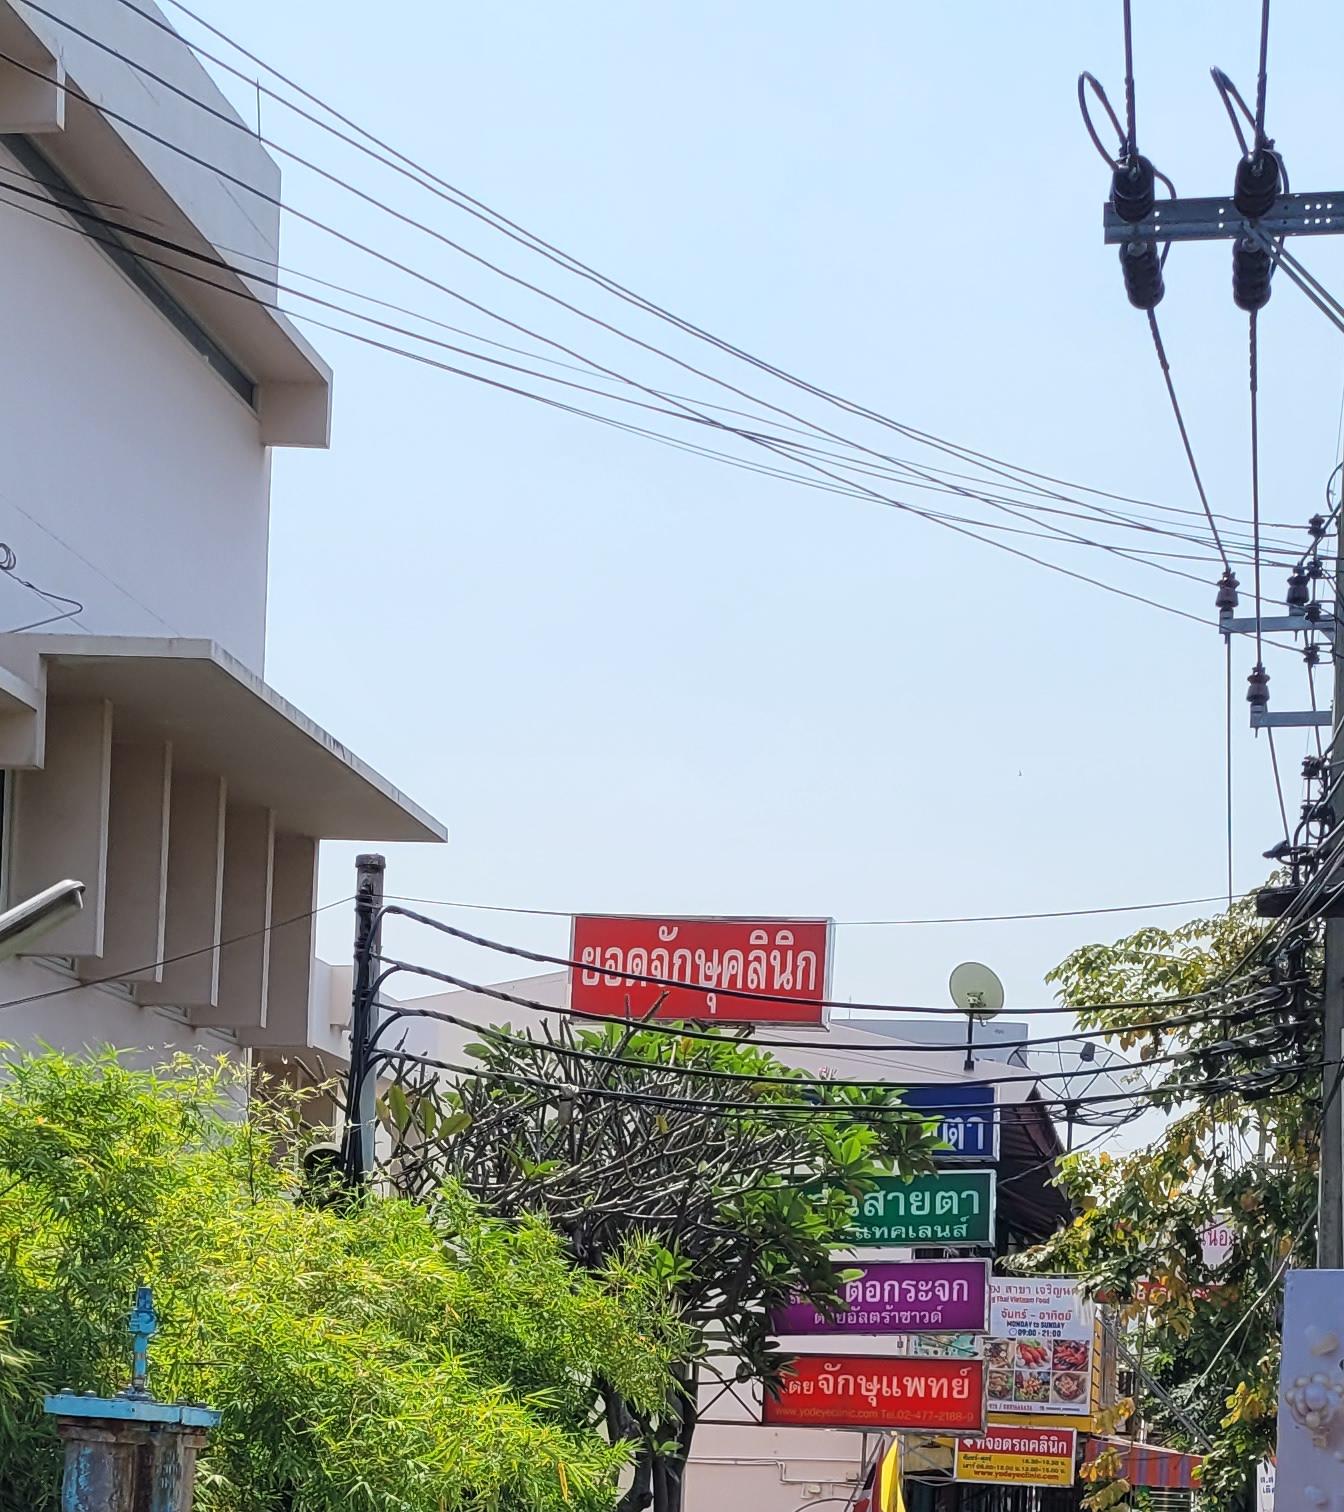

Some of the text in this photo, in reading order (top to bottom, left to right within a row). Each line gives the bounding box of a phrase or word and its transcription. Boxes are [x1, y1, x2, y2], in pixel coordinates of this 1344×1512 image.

[581, 925, 817, 1014] ยอดจักษุคลินิก
[1001, 1307, 1028, 1319] จันทร์
[1006, 1320, 1033, 1328] MONDAY
[1040, 1321, 1065, 1329] SUNDAY
[1041, 1329, 1062, 1337] 21:00
[817, 1362, 973, 1408] จักษุแพทย์
